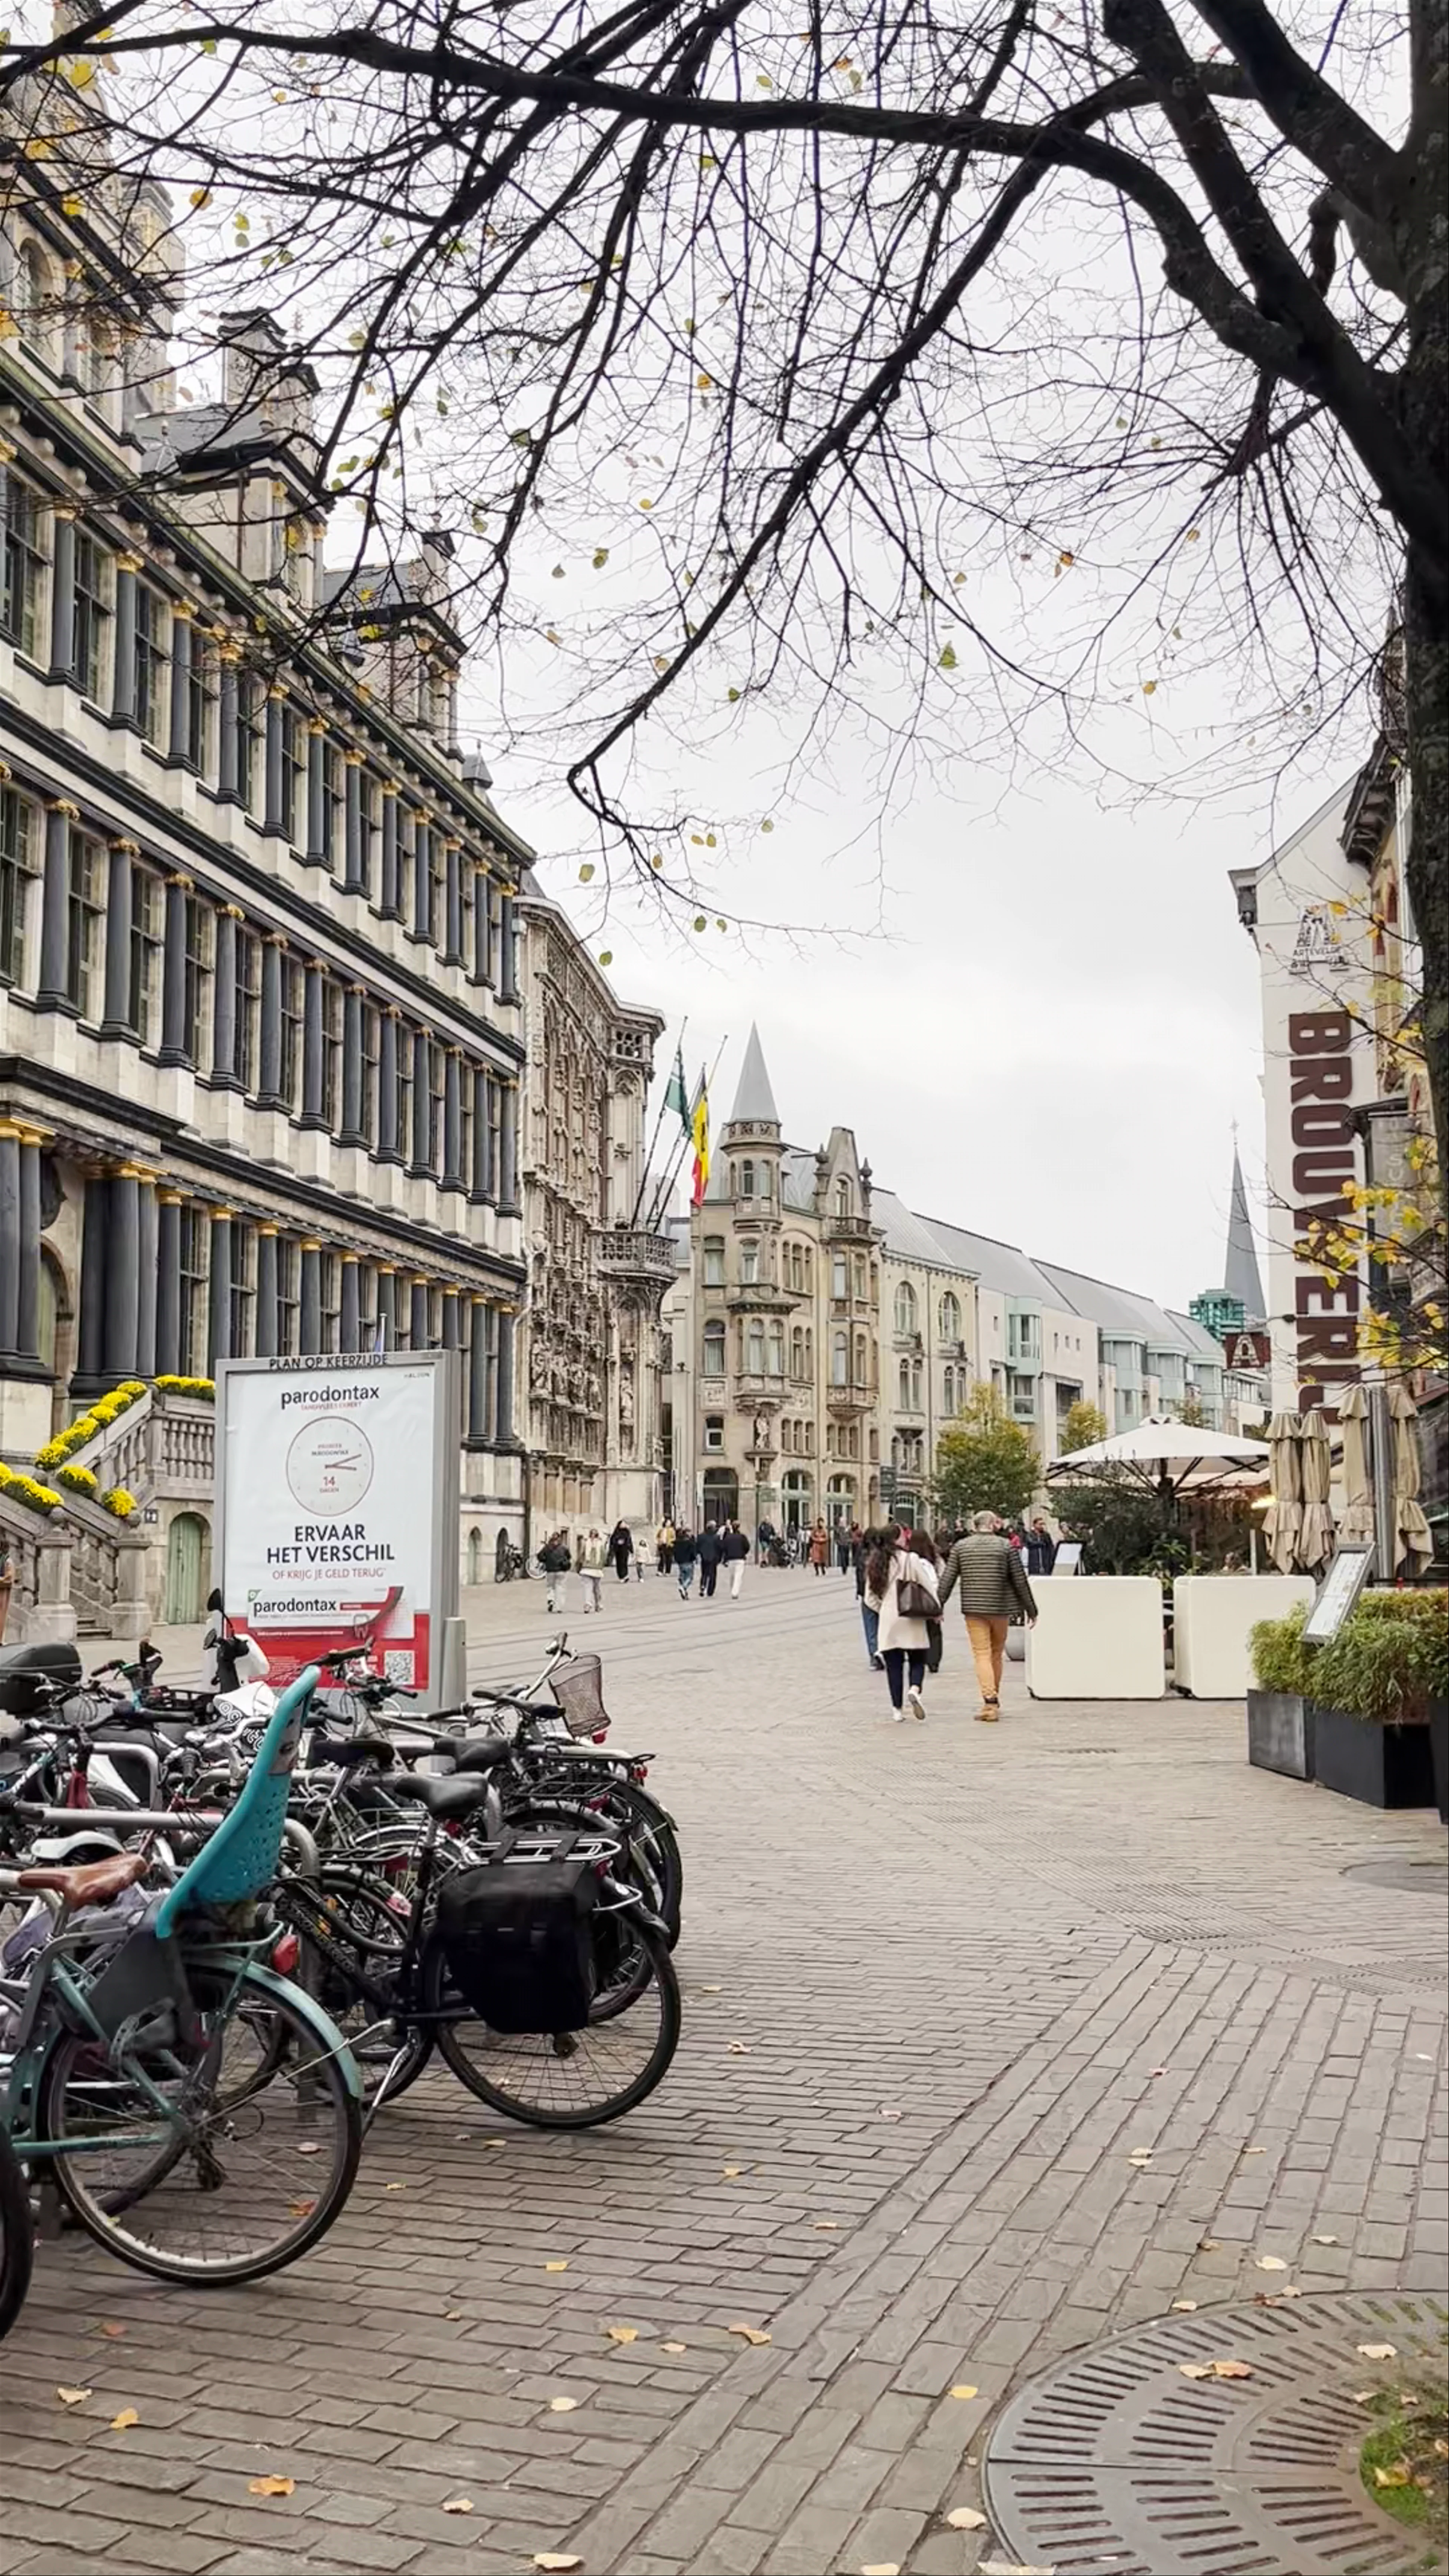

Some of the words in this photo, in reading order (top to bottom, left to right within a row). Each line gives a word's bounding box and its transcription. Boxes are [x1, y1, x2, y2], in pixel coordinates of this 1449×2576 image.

[269, 1358, 300, 1369] PLAN
[305, 1357, 323, 1369] OP
[326, 1354, 388, 1368] KEERZIJDE
[281, 1385, 380, 1410] parodontax
[323, 1476, 335, 1486] 14
[295, 1524, 366, 1542] ERVAAR
[267, 1547, 302, 1563] HET
[306, 1544, 395, 1563] VERSCHIL
[272, 1570, 285, 1580] OF
[288, 1570, 312, 1581] KRIJG
[314, 1569, 323, 1581] JE
[325, 1568, 350, 1578] GELD
[254, 1598, 337, 1618] parodontax
